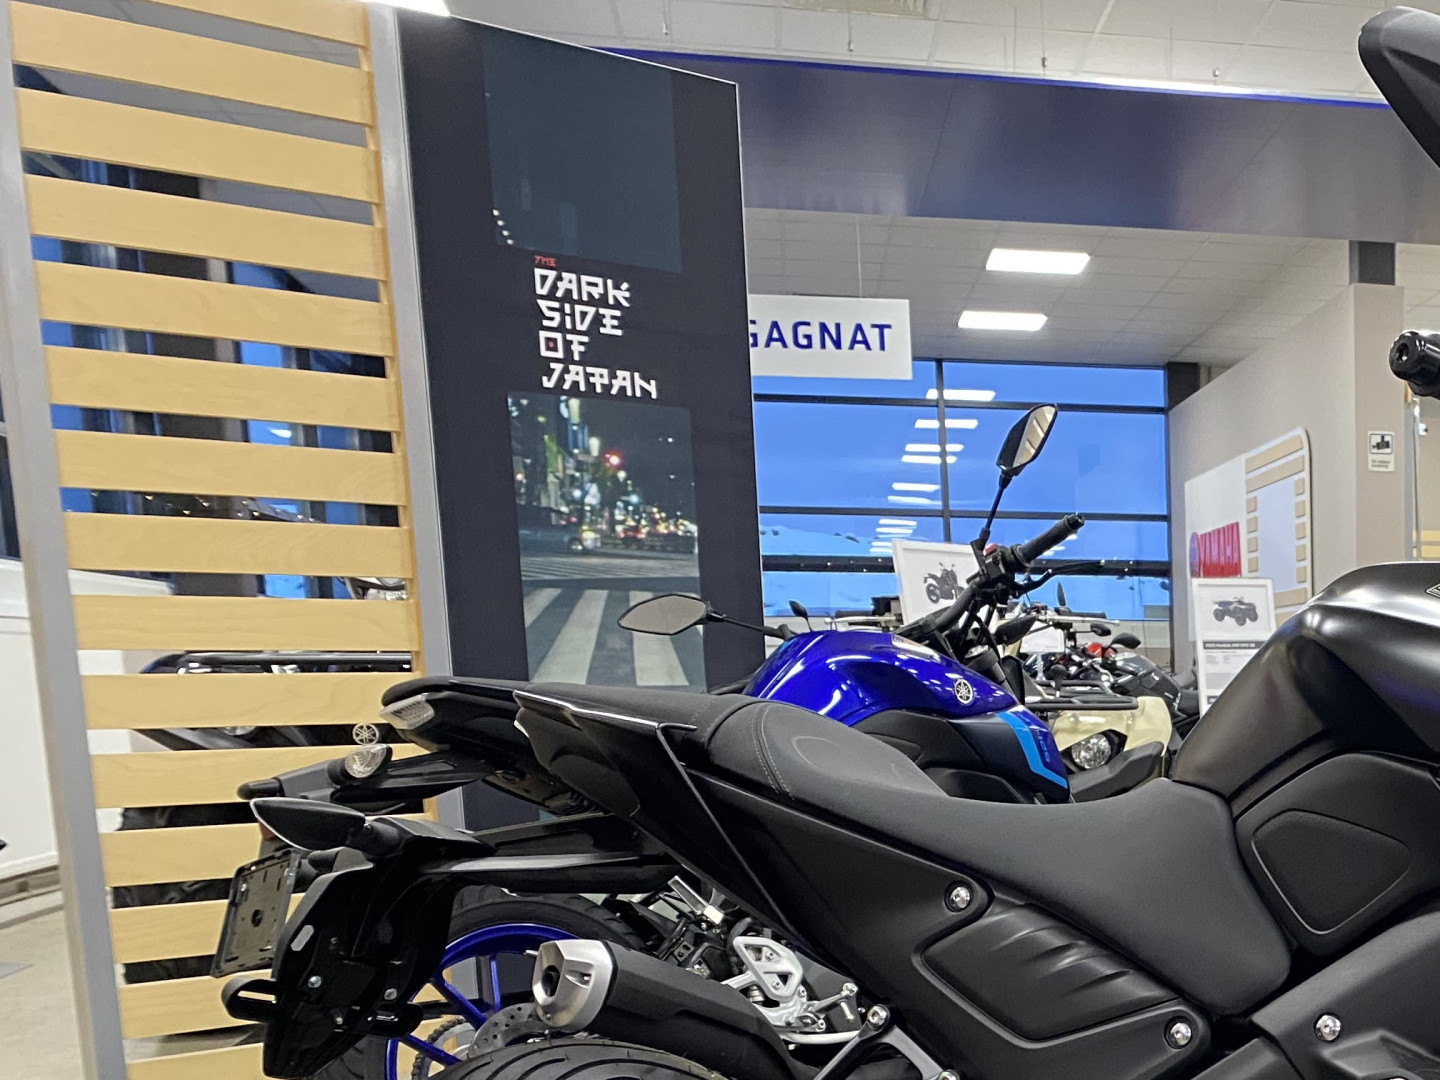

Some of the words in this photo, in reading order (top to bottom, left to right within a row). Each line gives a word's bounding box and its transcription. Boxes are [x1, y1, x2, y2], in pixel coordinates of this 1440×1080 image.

[534, 267, 631, 307] DARK
[538, 330, 590, 361] OF
[542, 362, 657, 399] JAPAN
